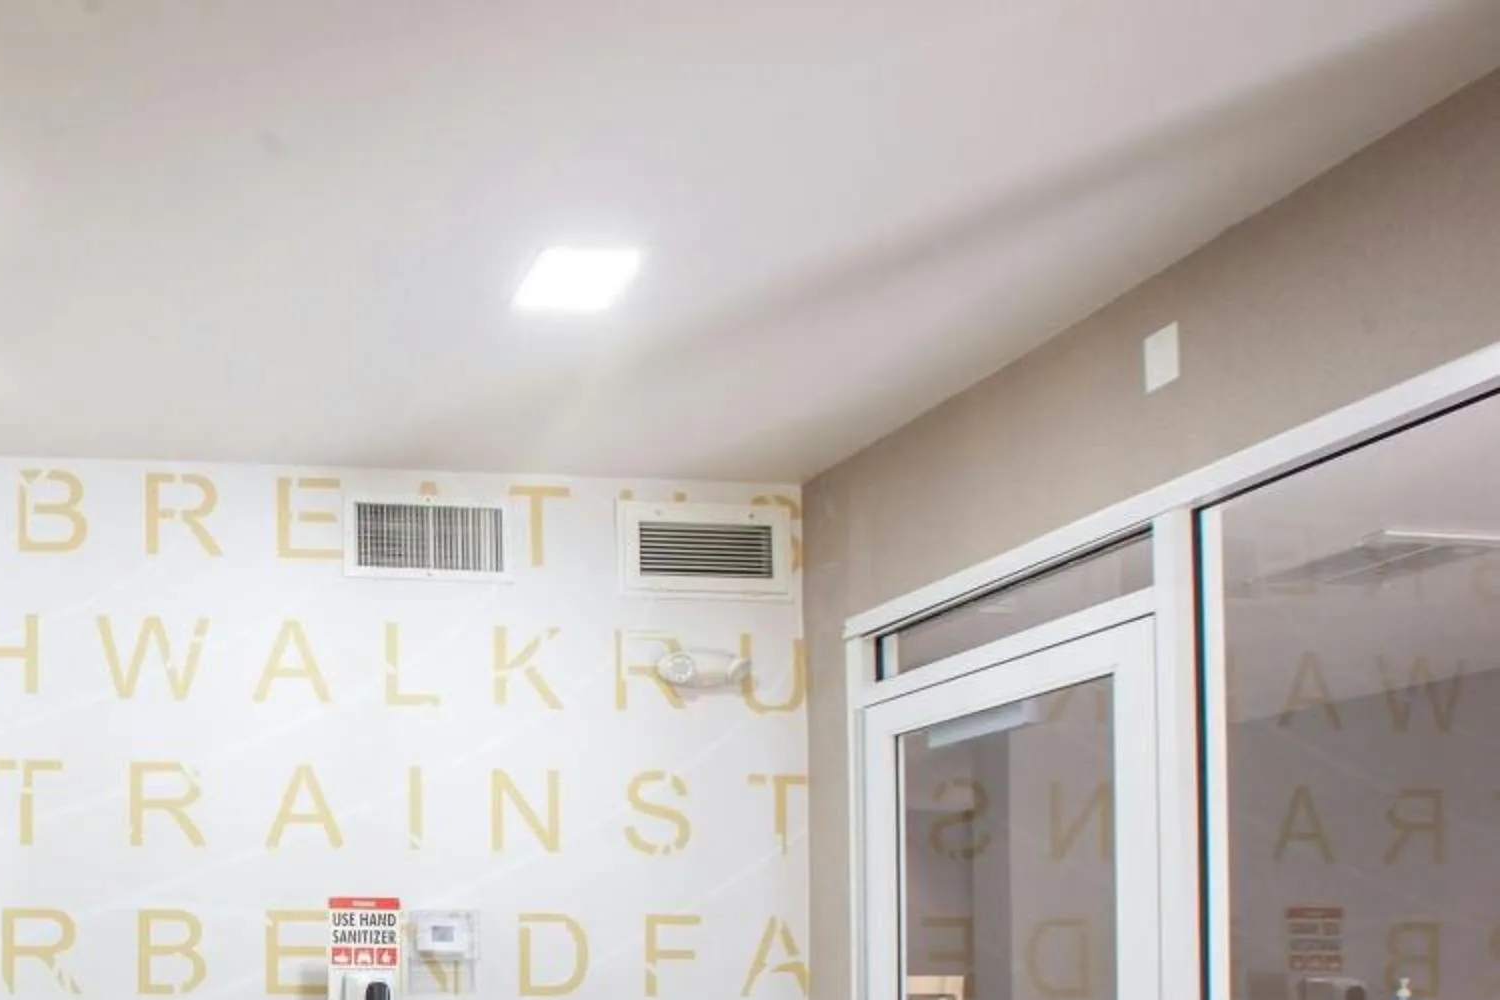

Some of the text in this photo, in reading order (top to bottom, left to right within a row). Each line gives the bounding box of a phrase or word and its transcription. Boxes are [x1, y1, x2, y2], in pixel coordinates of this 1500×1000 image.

[332, 912, 397, 927] USE HAND
[332, 929, 397, 945] SANITIZER
